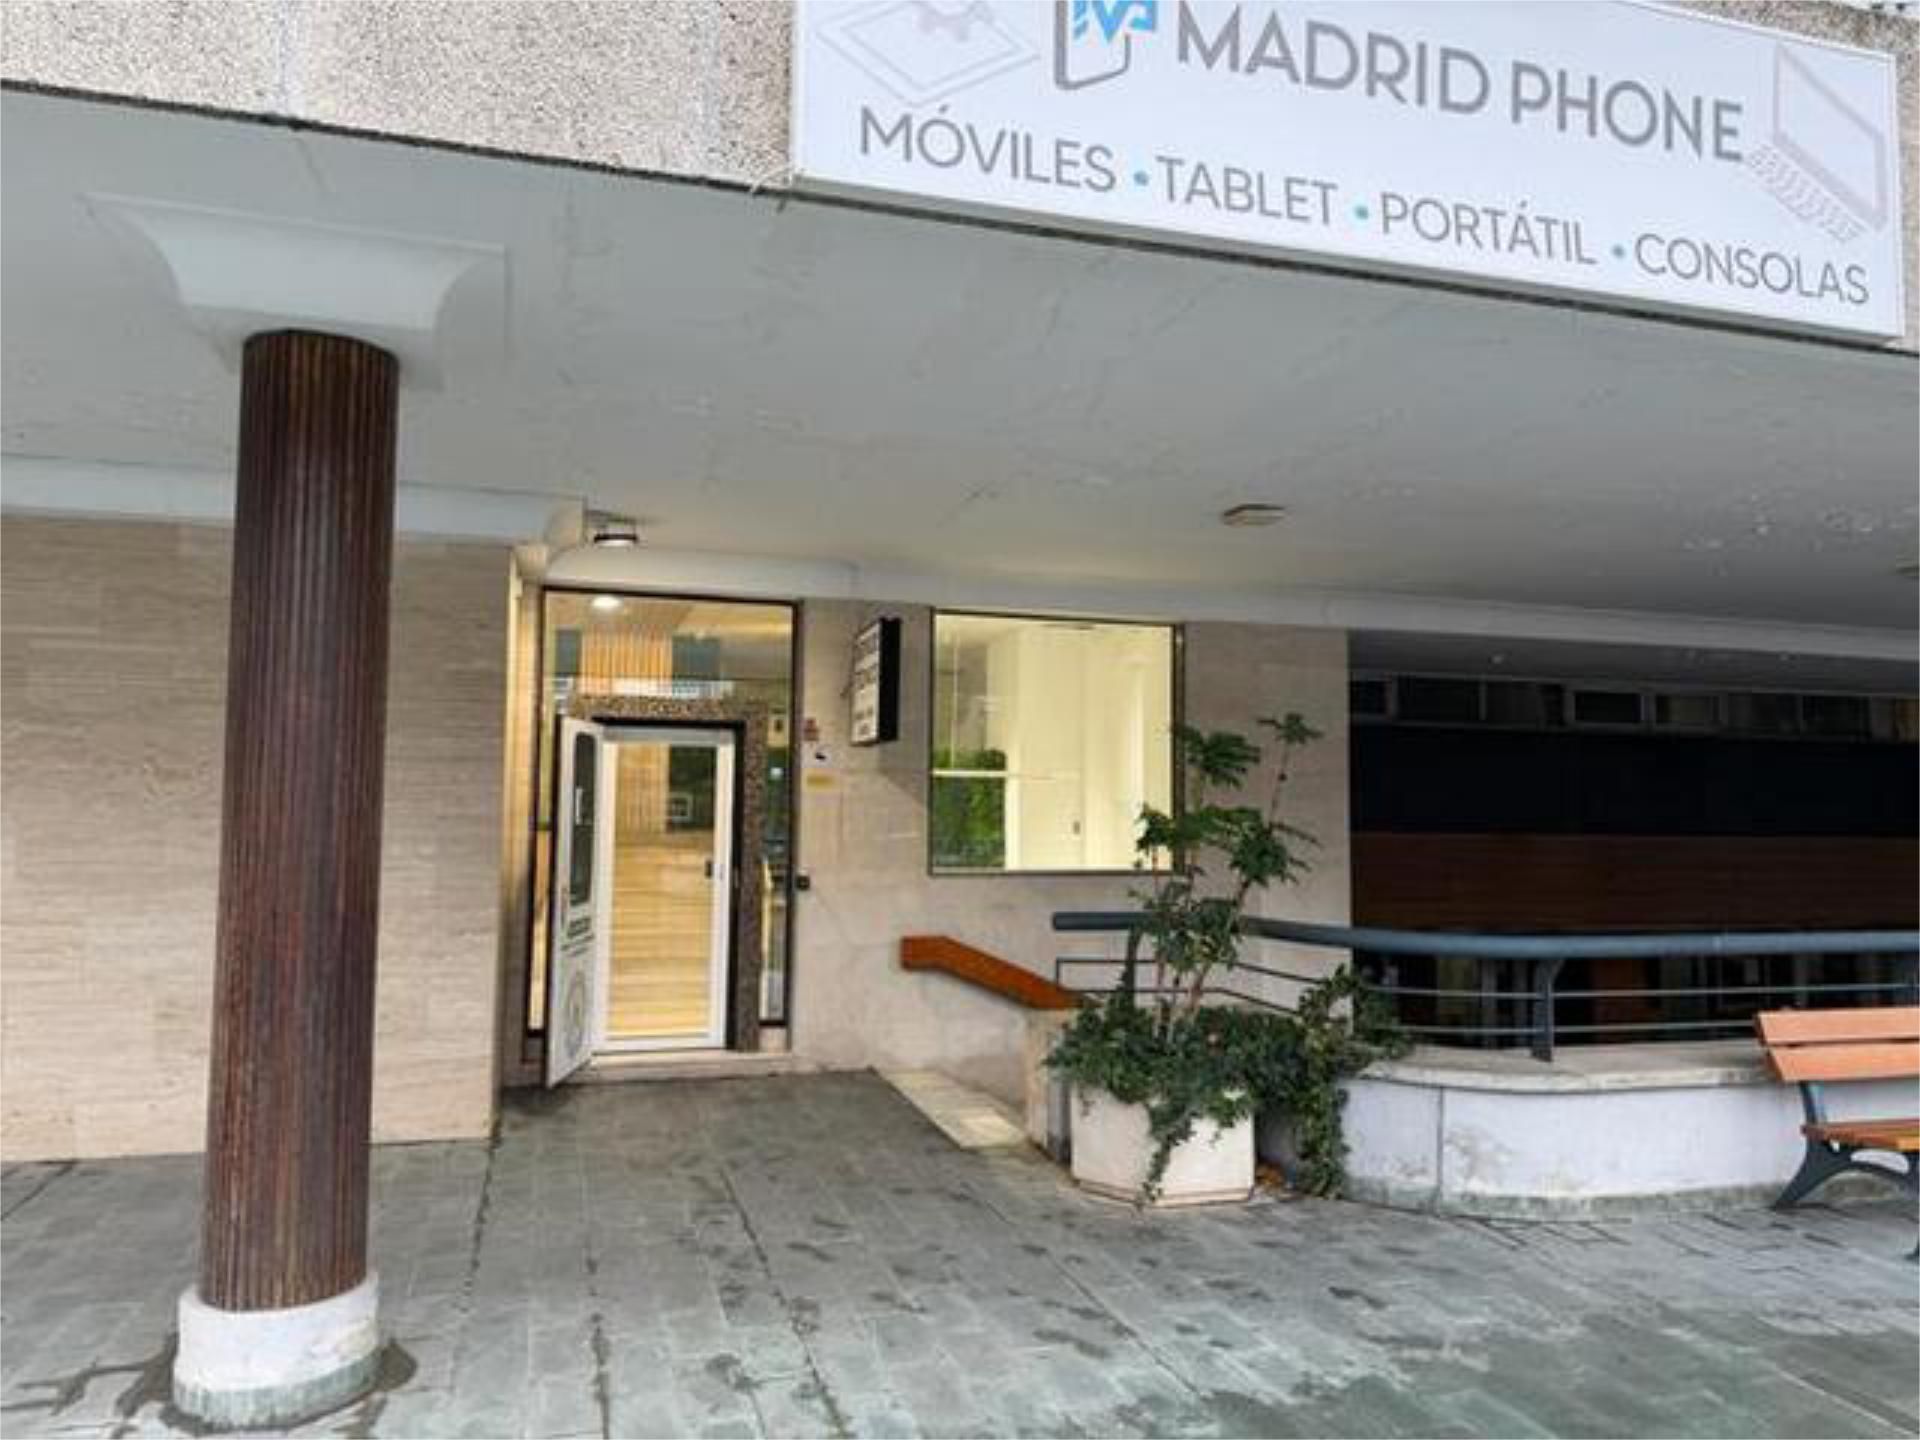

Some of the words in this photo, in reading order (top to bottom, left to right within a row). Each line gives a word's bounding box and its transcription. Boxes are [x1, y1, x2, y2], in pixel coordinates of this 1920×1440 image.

[1177, 2, 1490, 115] MADRID
[1512, 61, 1743, 162] PHONE
[861, 105, 1116, 193] MÓVILES
[1156, 155, 1338, 226] TABLET
[1381, 192, 1597, 266] PORTÁTIL
[1635, 232, 1870, 305] CONSOLAS
